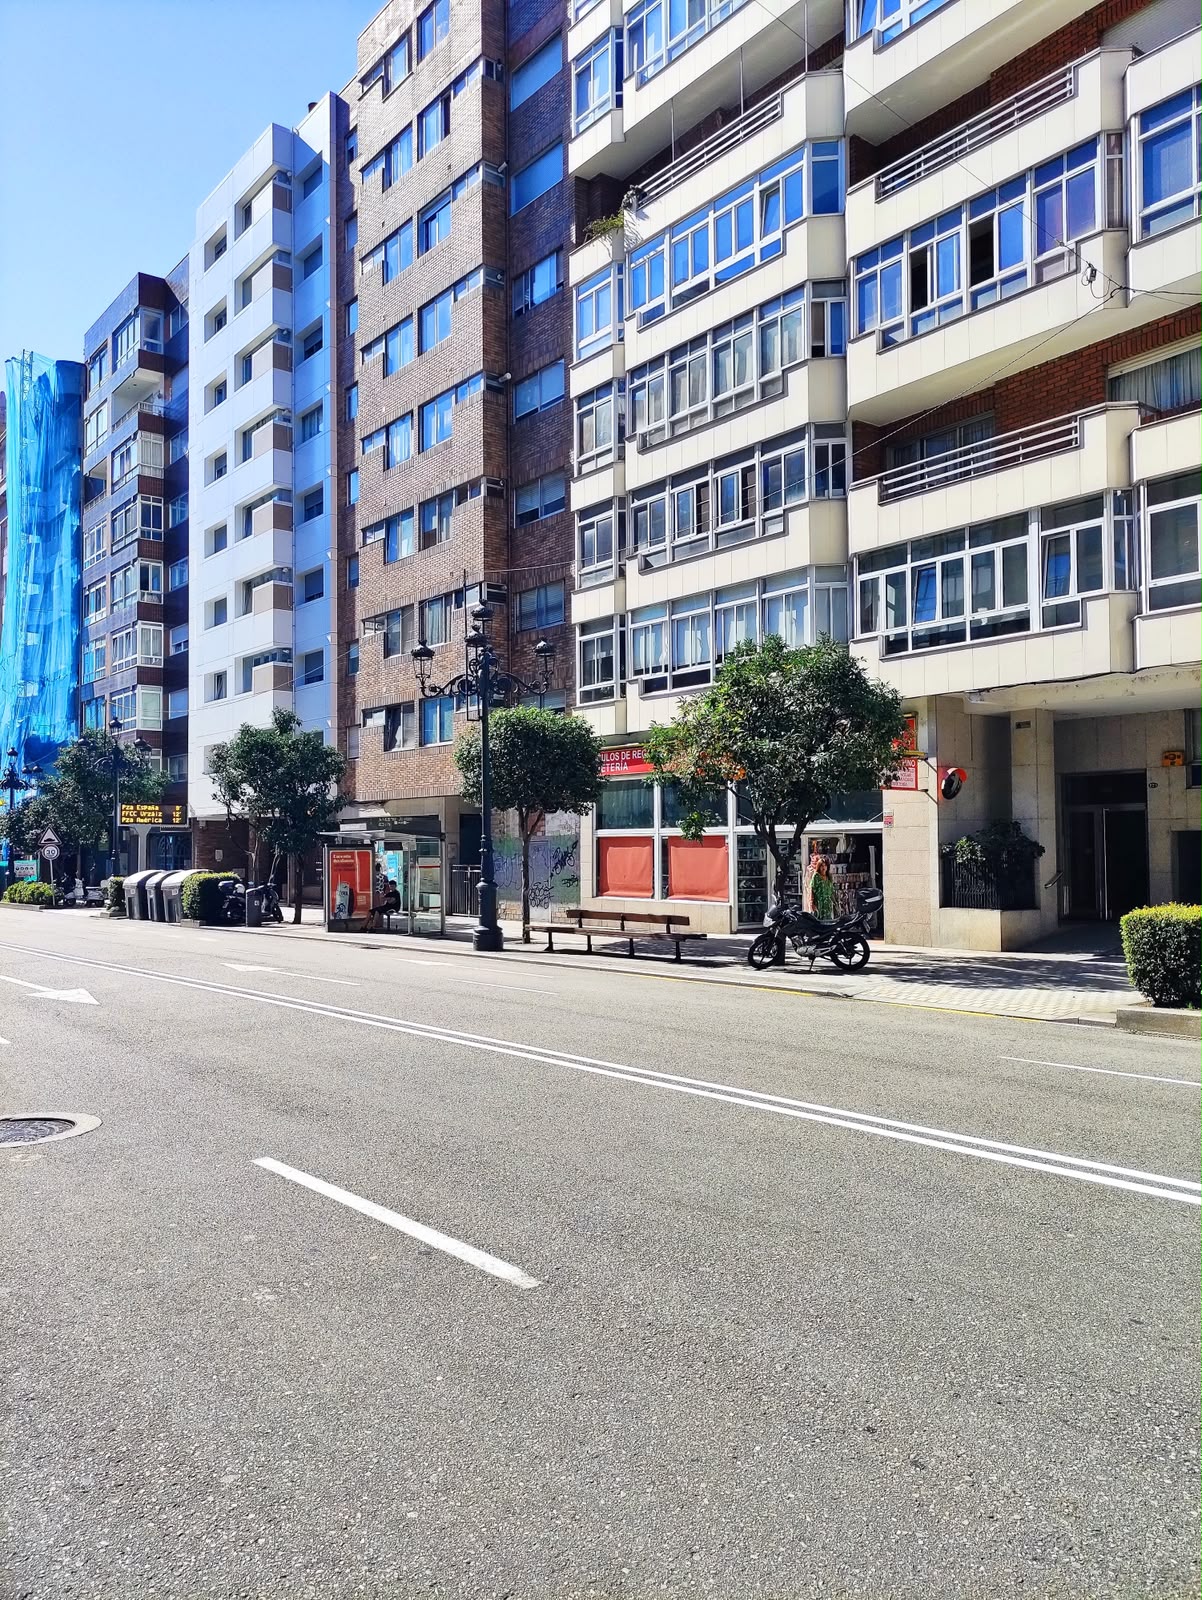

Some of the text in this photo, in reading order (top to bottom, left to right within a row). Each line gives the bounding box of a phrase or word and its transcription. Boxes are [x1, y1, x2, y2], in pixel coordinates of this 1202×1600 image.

[601, 752, 620, 761] ULOS
[621, 750, 631, 760] DE
[600, 761, 628, 772] ETERÍA
